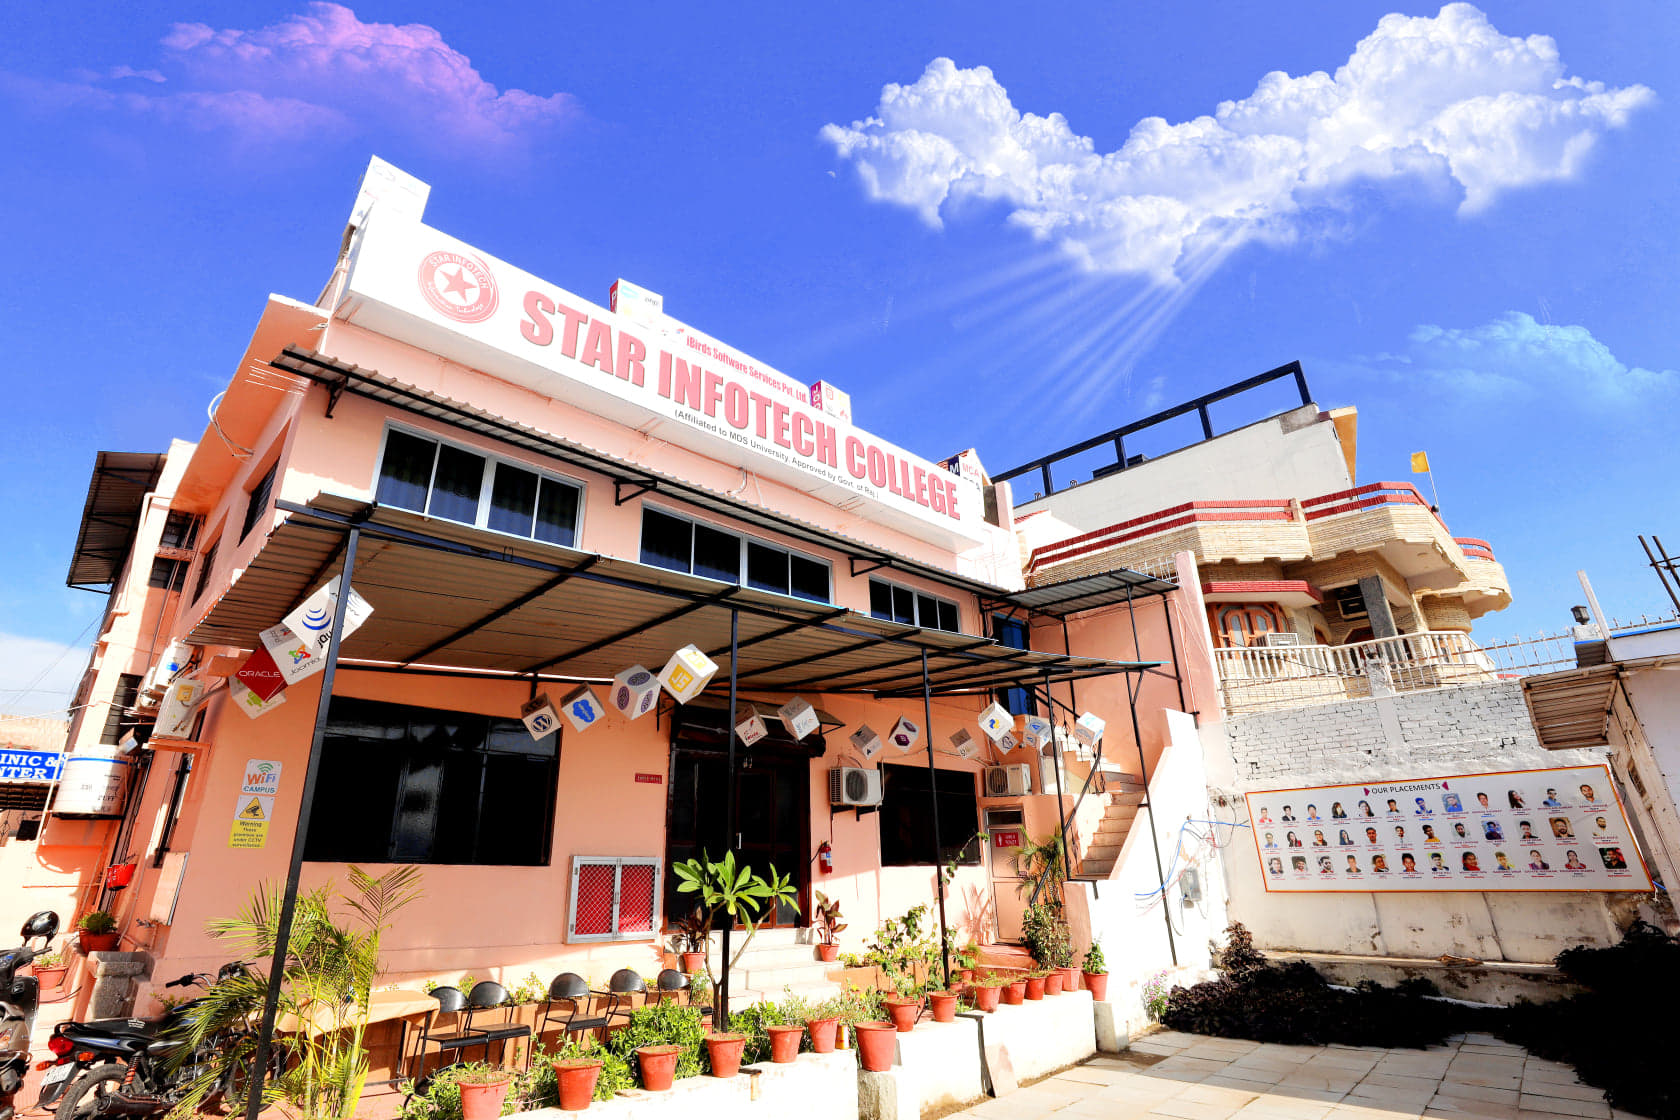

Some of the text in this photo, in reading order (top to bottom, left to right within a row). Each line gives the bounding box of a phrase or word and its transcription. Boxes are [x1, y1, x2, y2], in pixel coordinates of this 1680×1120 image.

[686, 335, 712, 357] iBirds
[713, 348, 748, 374] Software
[749, 365, 782, 391] Services
[519, 290, 961, 520] STAR INFOTECH COLLEGE
[674, 408, 717, 433] (Affiliated
[719, 427, 728, 437] to
[729, 431, 749, 445] MDS
[792, 456, 827, 476] Approved
[827, 471, 837, 482] by
[962, 462, 980, 478] MCA
[238, 670, 281, 678] ORACLE
[671, 672, 690, 688] JS
[247, 772, 276, 786] WiFi
[243, 785, 275, 794] CAMPUS
[1390, 783, 1441, 793] PLACEMENTS
